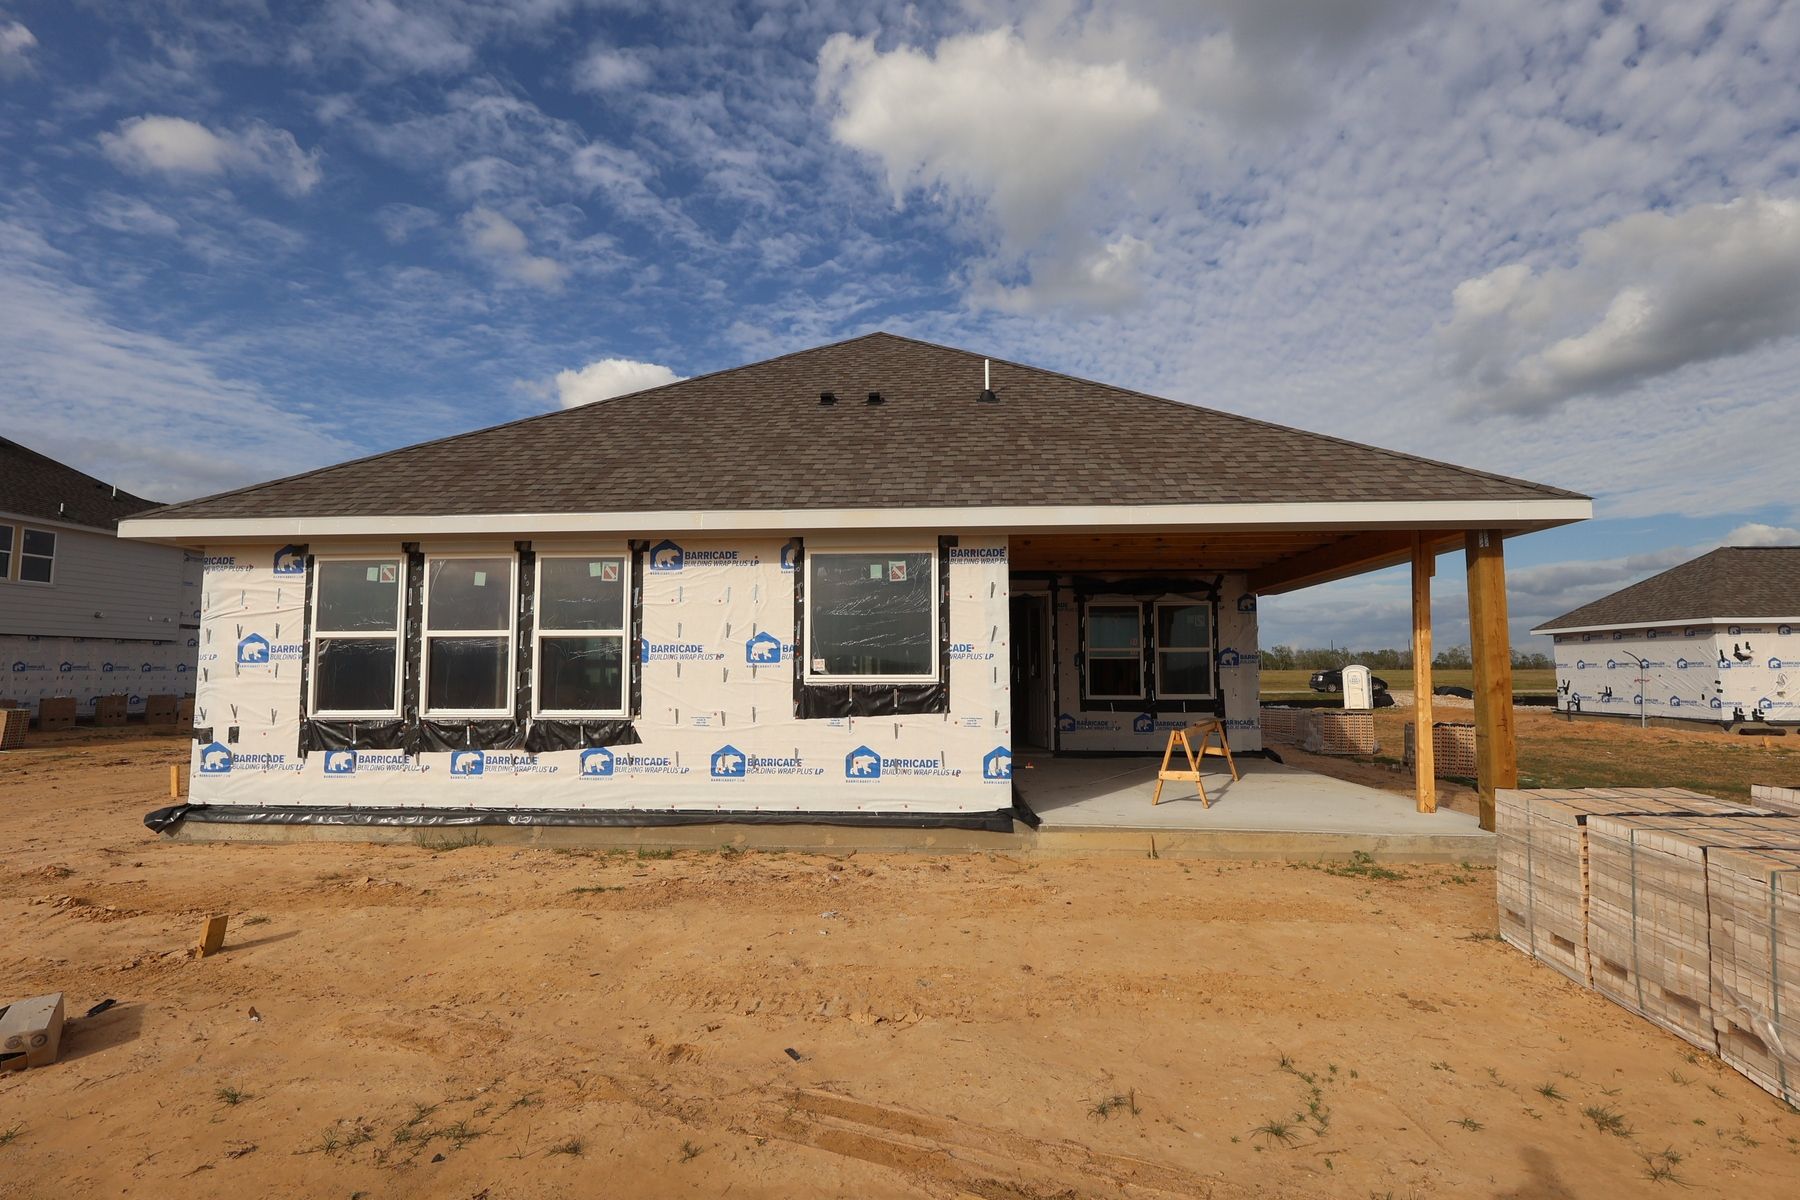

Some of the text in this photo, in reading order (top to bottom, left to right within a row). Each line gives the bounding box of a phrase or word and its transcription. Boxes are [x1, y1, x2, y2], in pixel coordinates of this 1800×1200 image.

[684, 552, 738, 560] BARRICADE
[951, 549, 1004, 558] BARRICADE
[651, 645, 703, 653] BARRICADE
[234, 754, 285, 763] BARRICADE
[358, 755, 410, 764] BARRICADE
[486, 756, 538, 765] BARRICADE
[616, 757, 669, 766] BARRICADE
[748, 758, 802, 767] BARRICADE
[882, 759, 939, 768] BARRICADE
